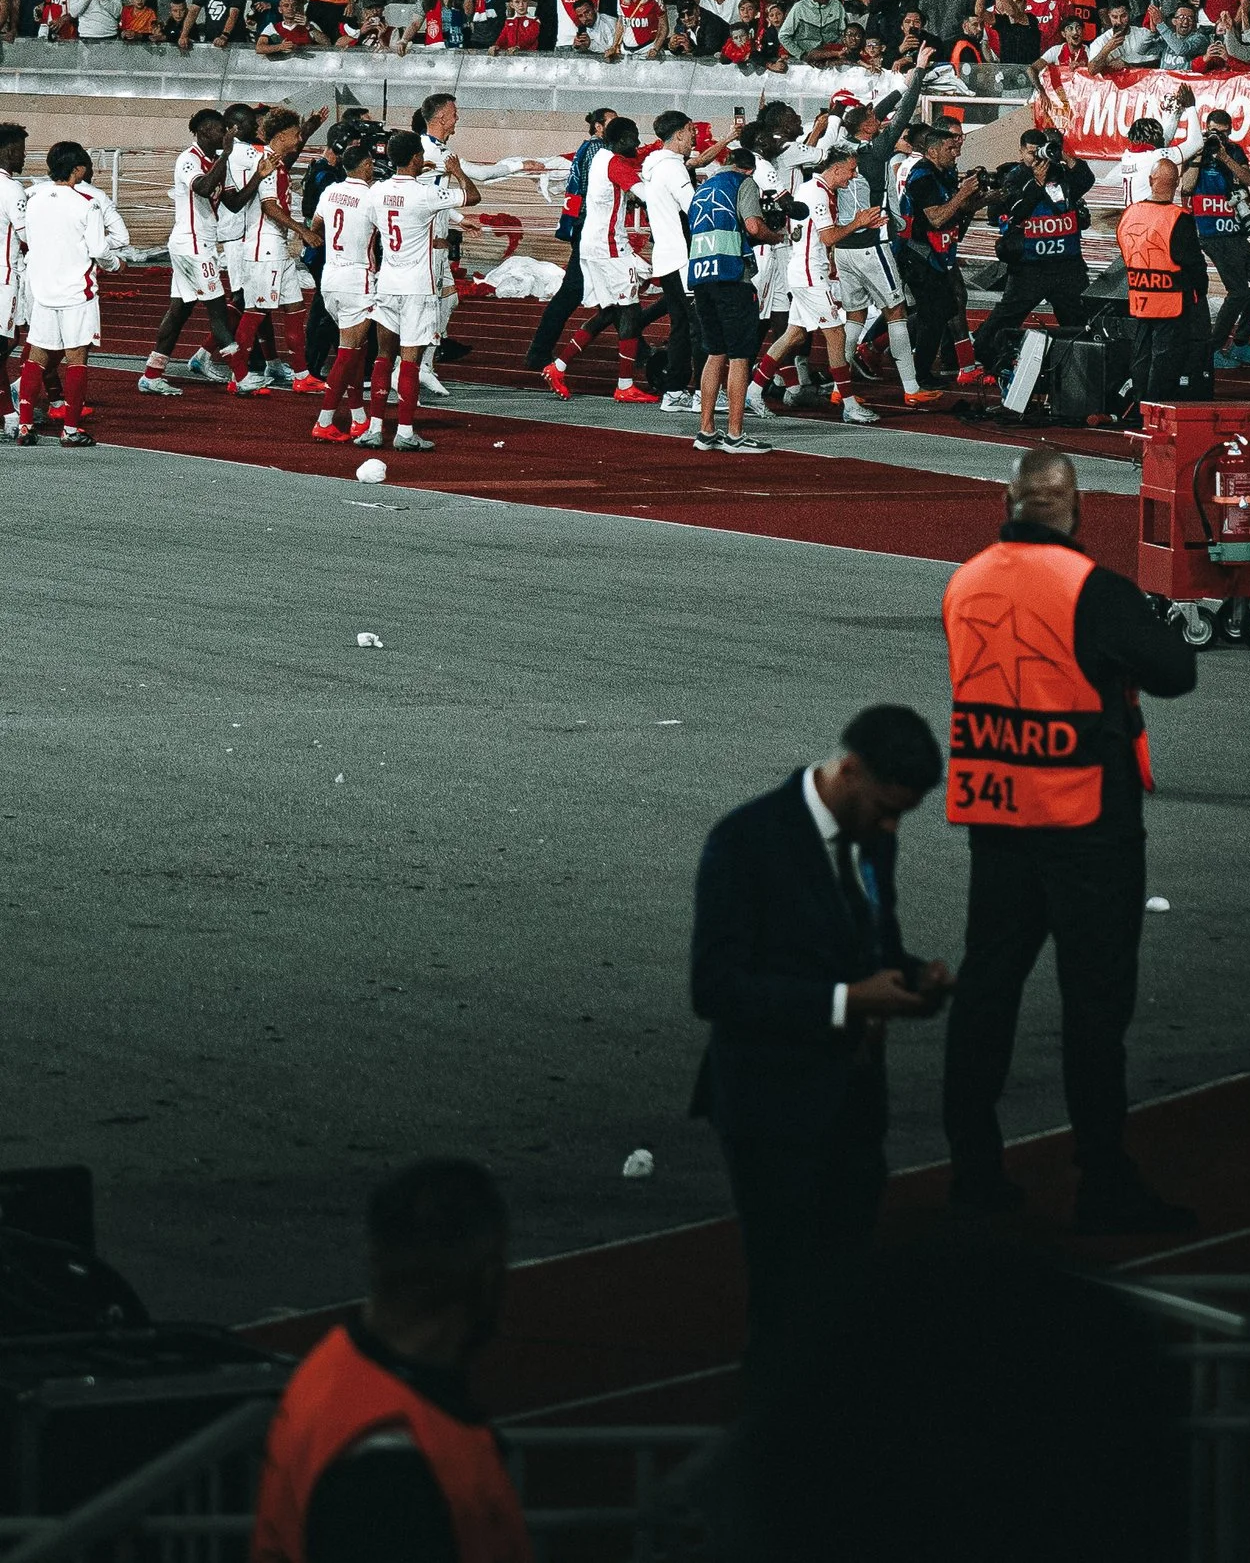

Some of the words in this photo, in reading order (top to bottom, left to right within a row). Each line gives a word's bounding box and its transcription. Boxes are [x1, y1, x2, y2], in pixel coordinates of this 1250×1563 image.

[333, 208, 345, 252] 2
[387, 210, 403, 252] 5
[1024, 217, 1073, 234] PHOTO
[693, 236, 717, 255] TV
[1035, 239, 1065, 255] 025
[202, 262, 216, 278] 36
[271, 270, 278, 287] 7
[693, 259, 719, 279] 021
[955, 771, 1018, 813] 341
